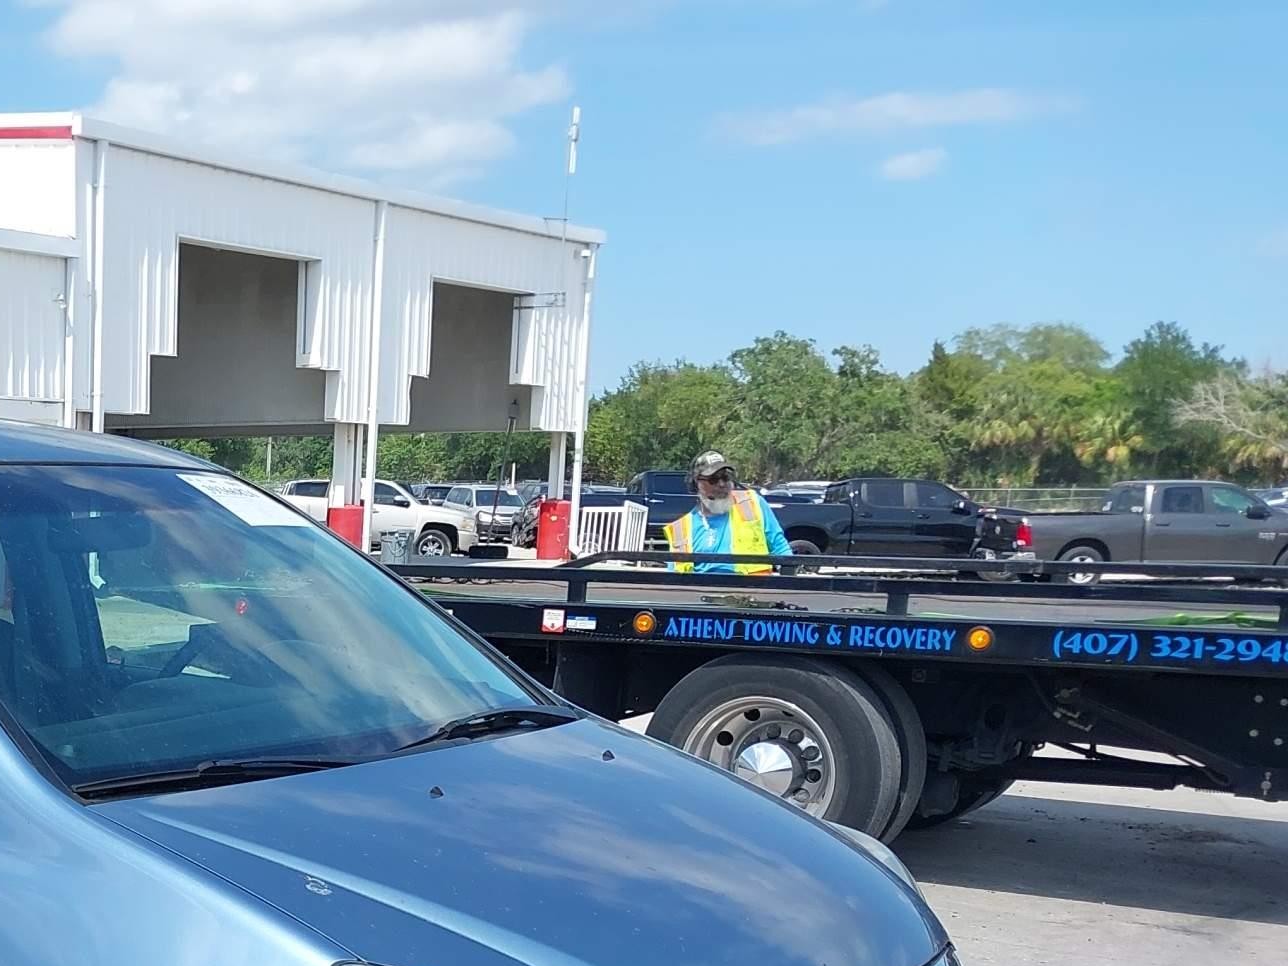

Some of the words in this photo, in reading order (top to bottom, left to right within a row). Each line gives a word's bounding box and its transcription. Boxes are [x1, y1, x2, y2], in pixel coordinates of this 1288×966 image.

[664, 617, 737, 640] ATHENS
[742, 619, 819, 644] TOWING
[826, 625, 842, 646] &
[849, 625, 956, 651] RECOVERY
[1053, 630, 1138, 662] (407)
[1150, 635, 1288, 663] 321-294
